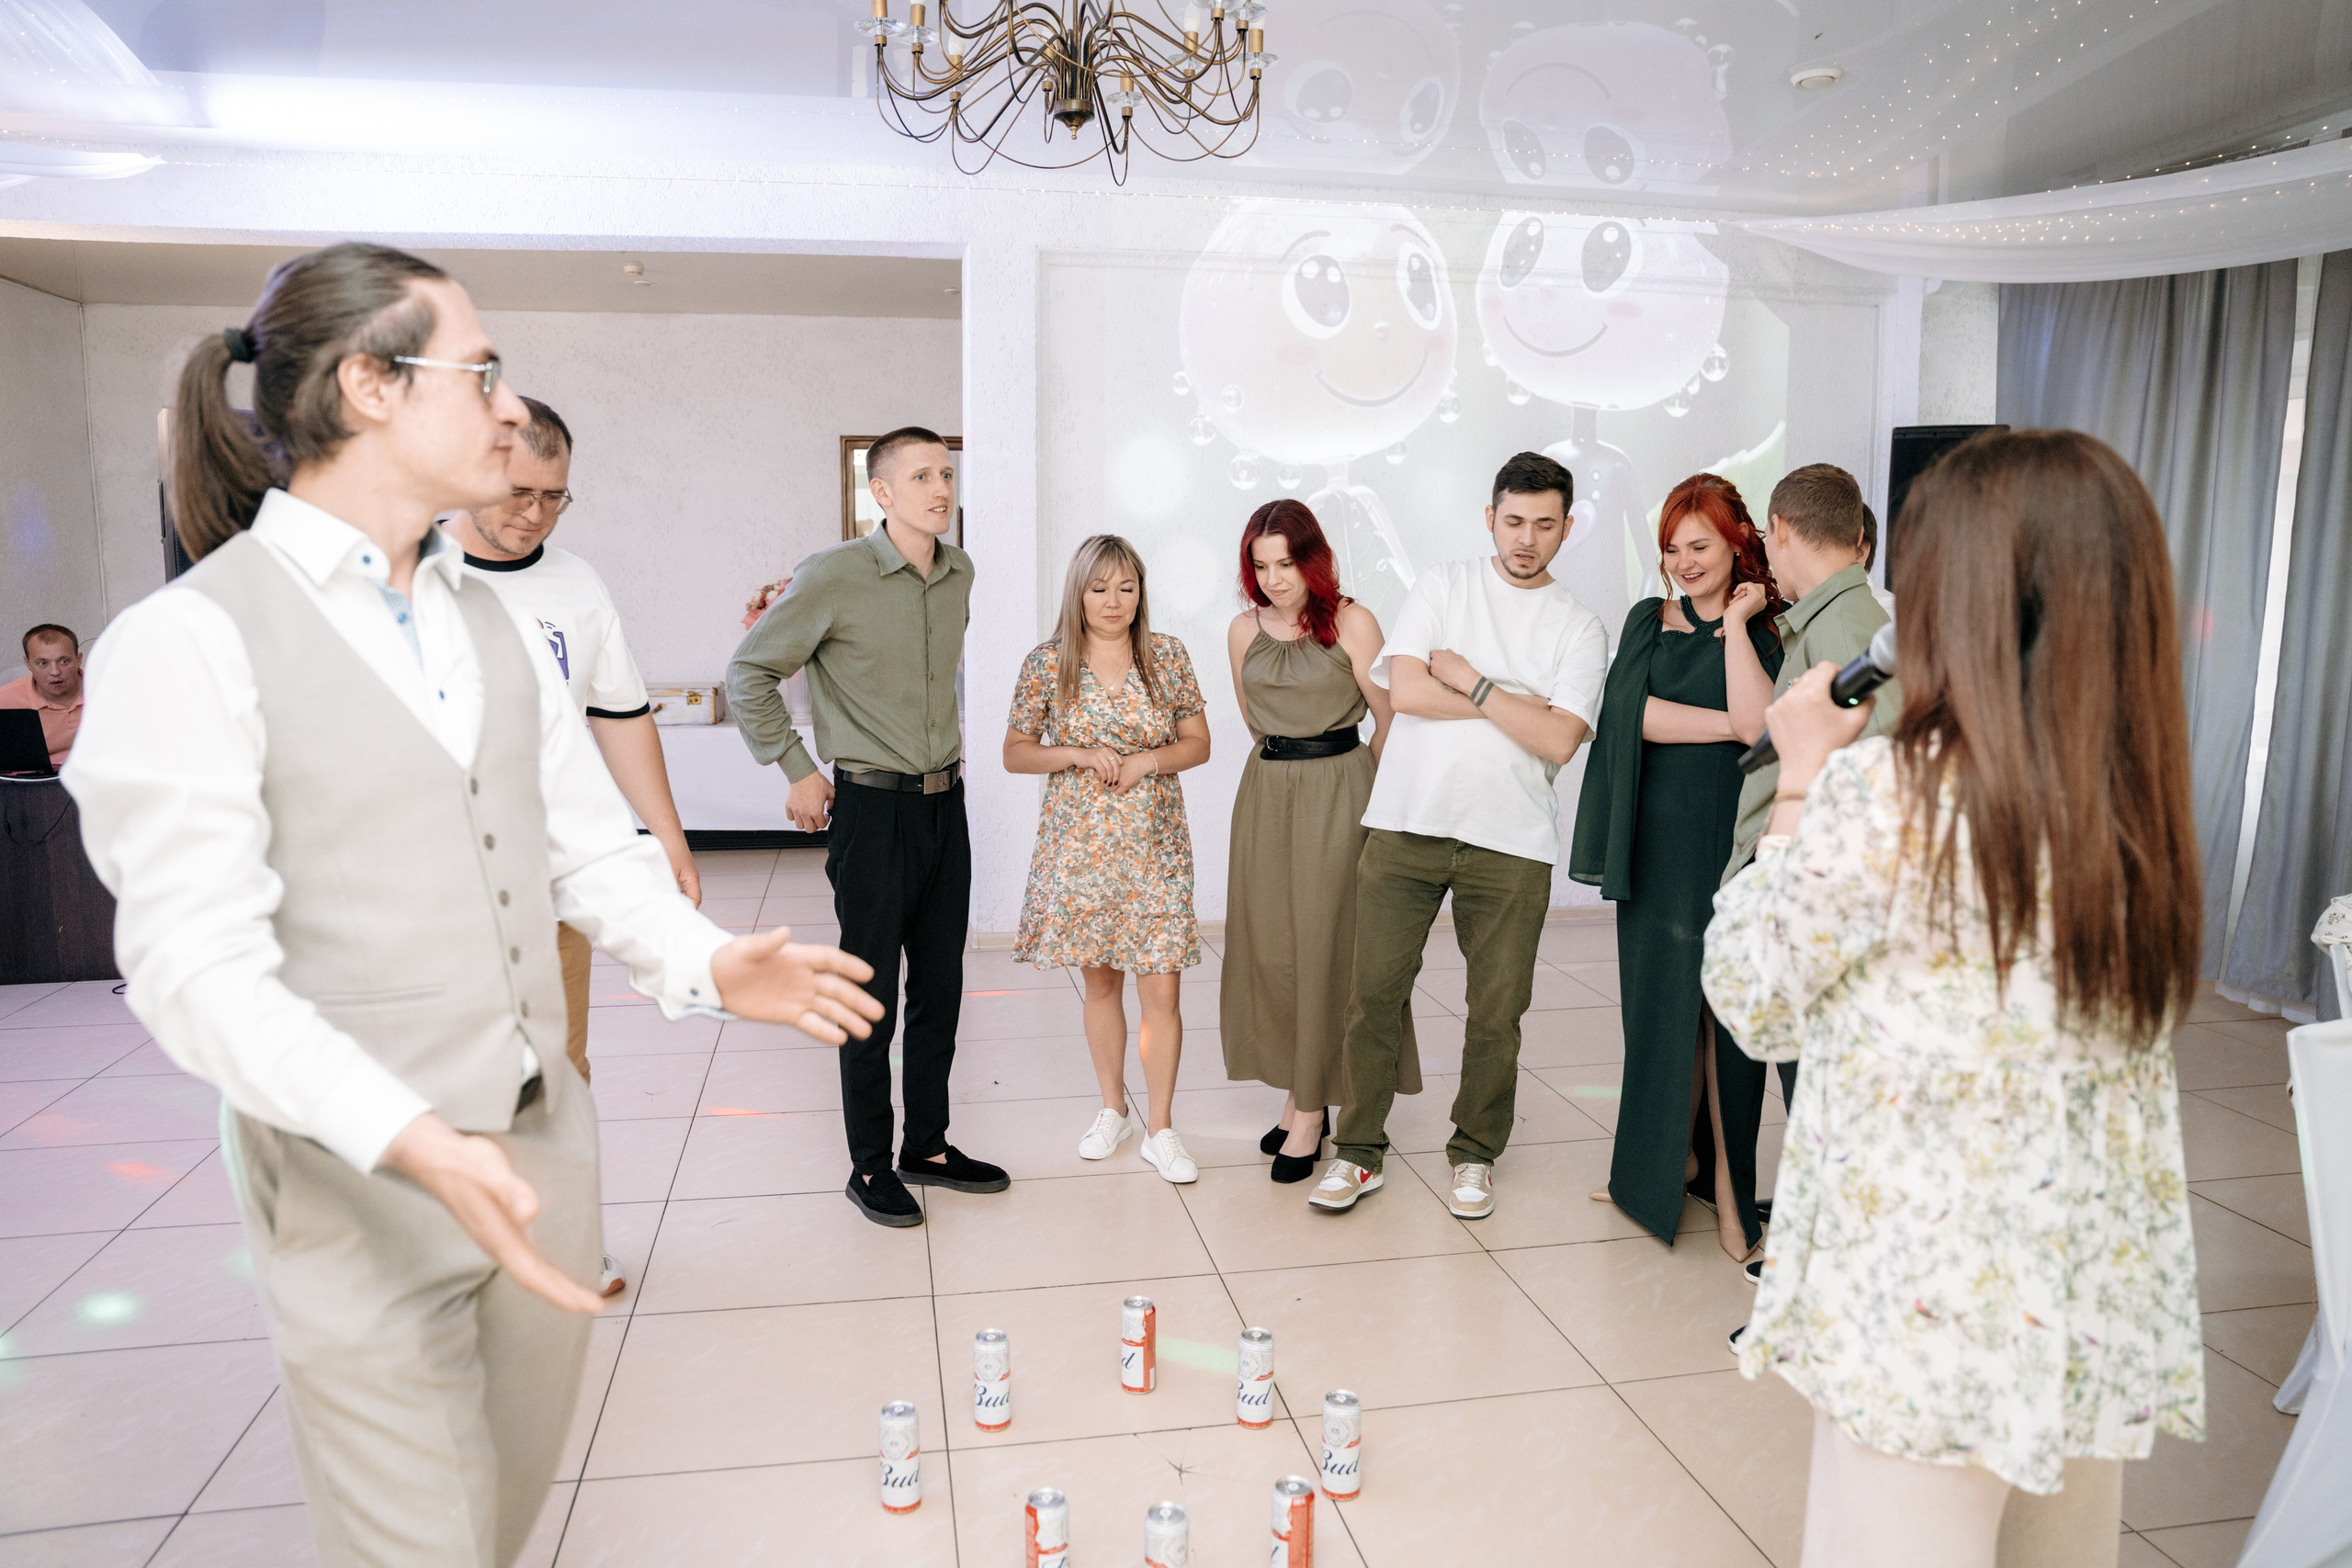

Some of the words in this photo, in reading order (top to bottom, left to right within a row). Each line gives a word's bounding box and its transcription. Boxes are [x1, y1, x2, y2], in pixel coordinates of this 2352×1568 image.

[973, 1382, 1010, 1407] Bud
[1321, 1446, 1361, 1474] Bud
[879, 1461, 920, 1488] Bud
